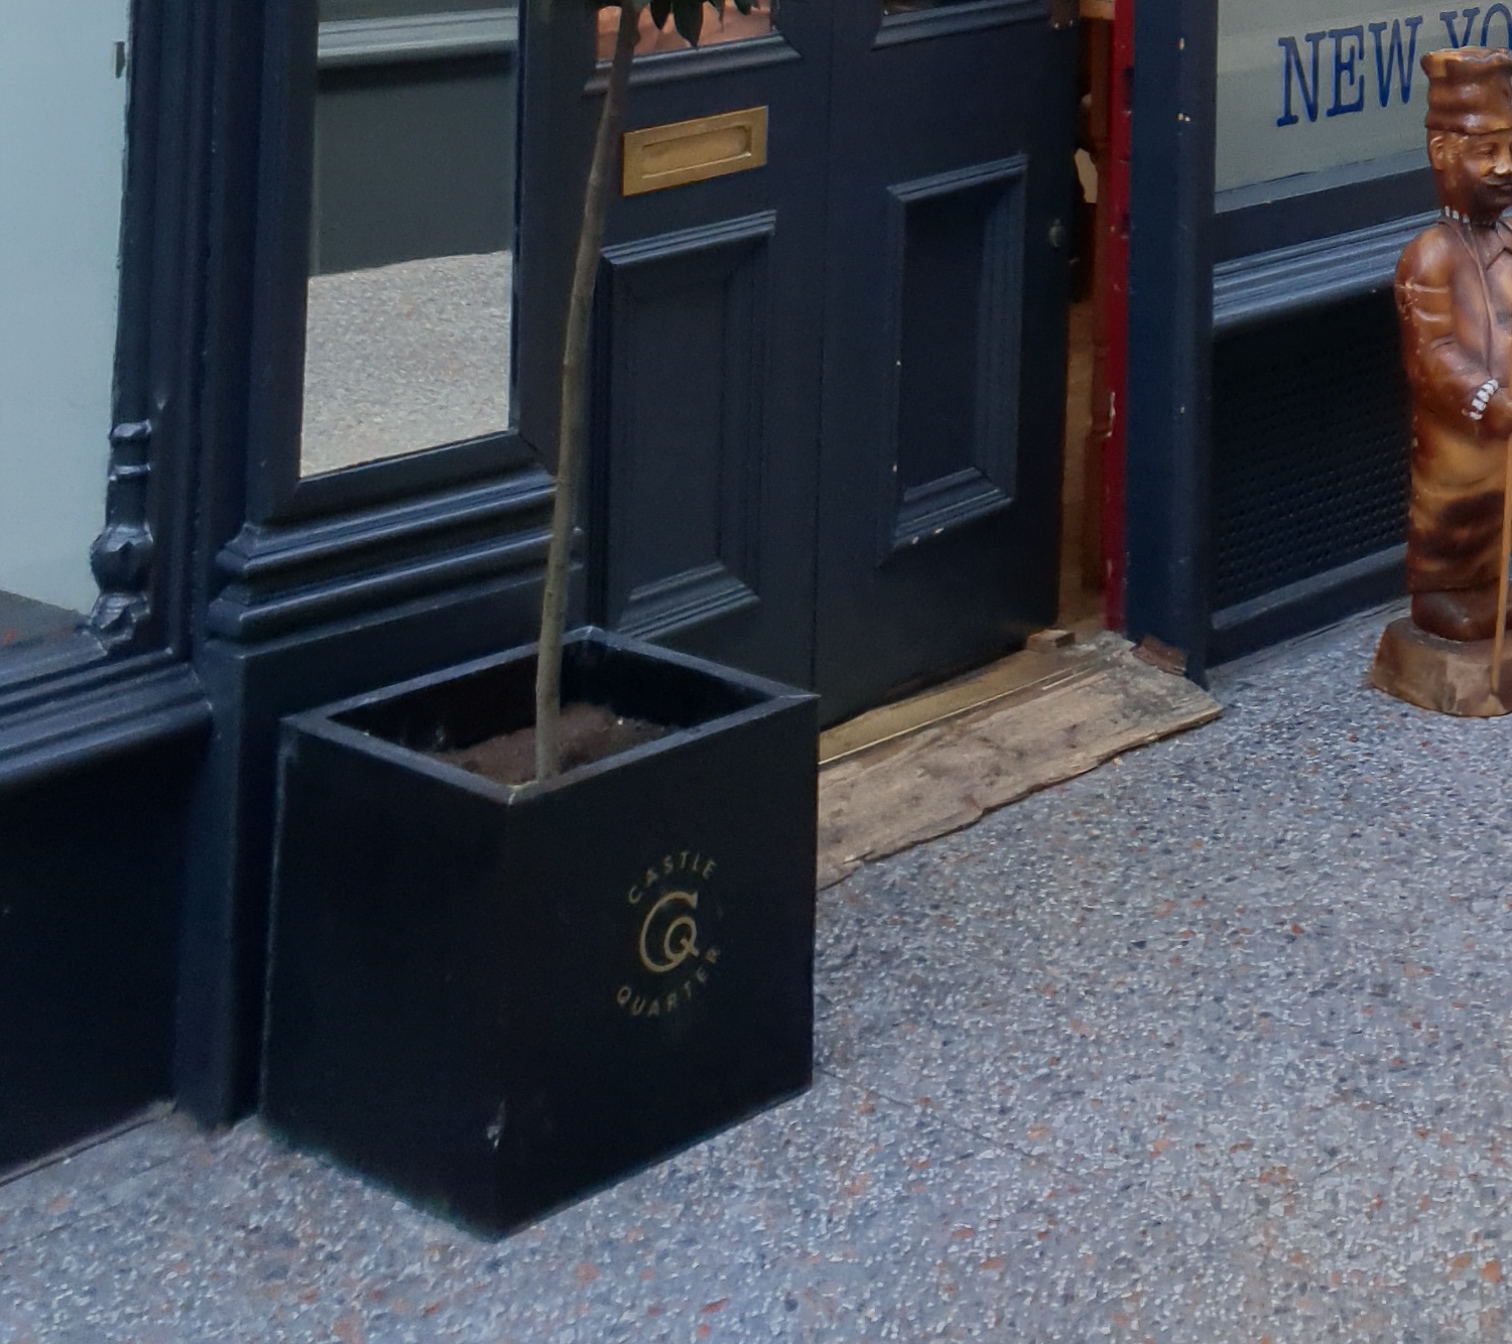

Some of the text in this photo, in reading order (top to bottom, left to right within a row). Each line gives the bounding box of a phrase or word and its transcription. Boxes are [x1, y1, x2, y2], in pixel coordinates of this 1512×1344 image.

[1275, 16, 1423, 128] NEW
[628, 850, 719, 905] CASTLE
[616, 947, 721, 1016] QUARTER
